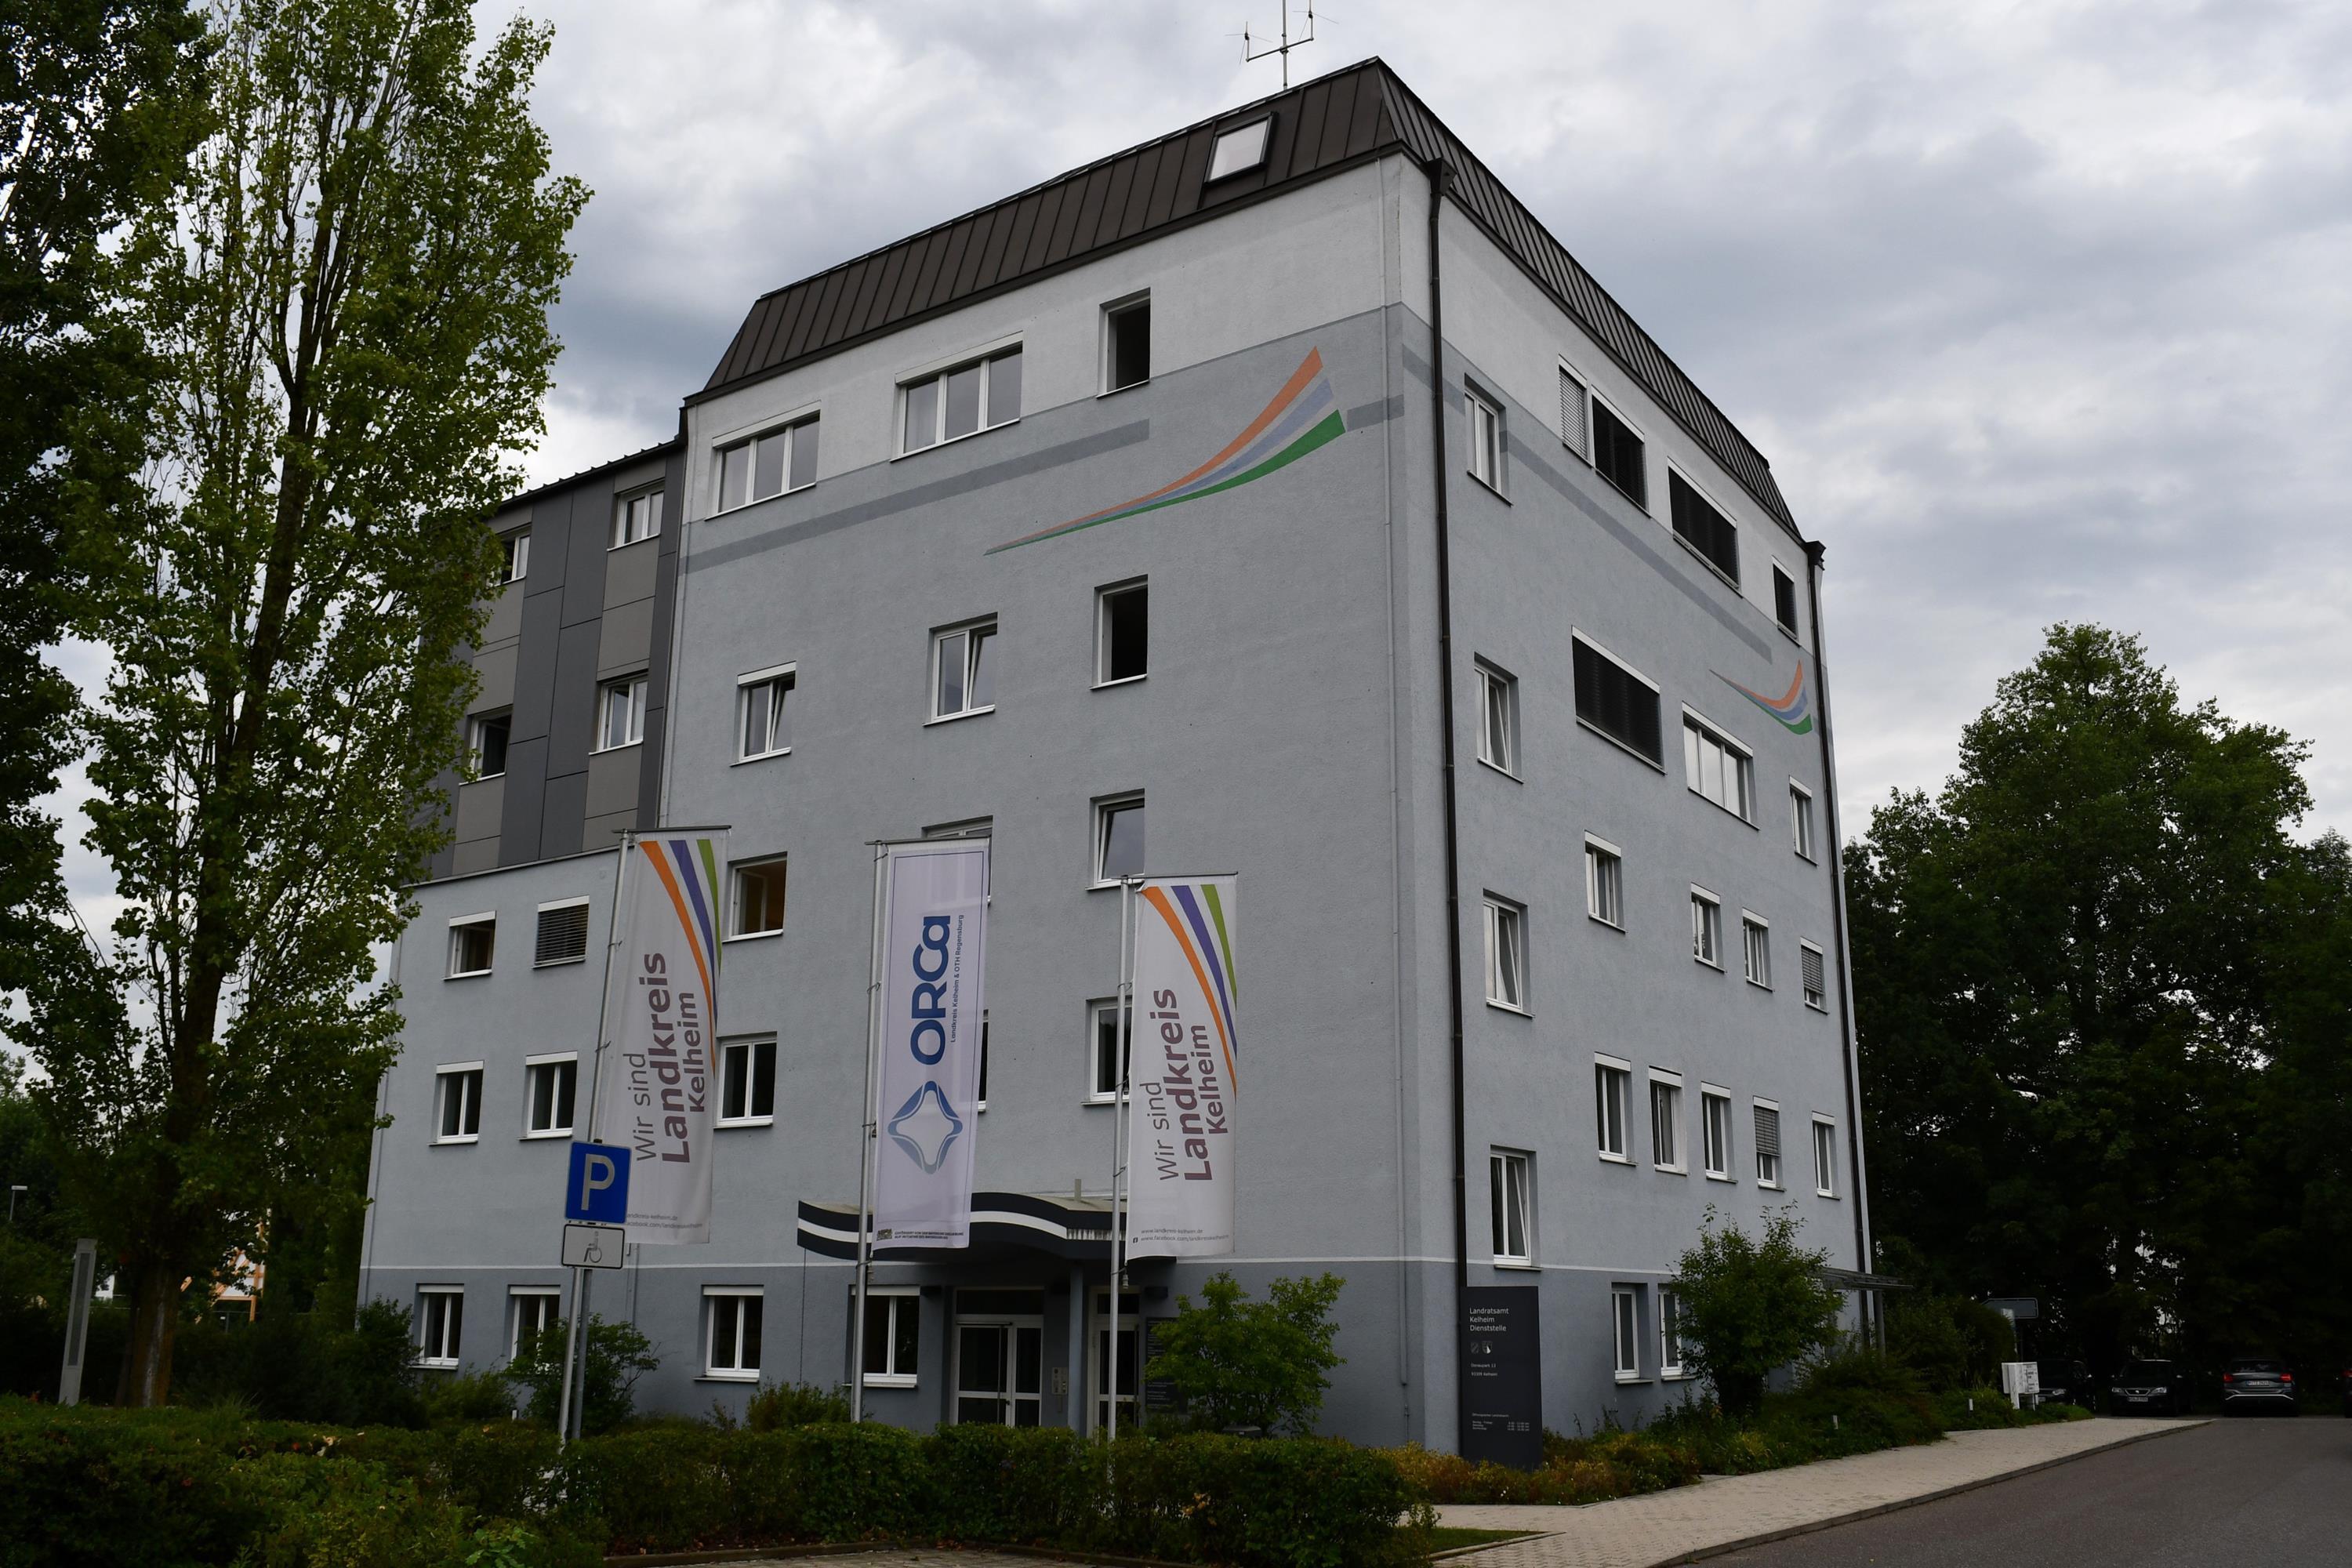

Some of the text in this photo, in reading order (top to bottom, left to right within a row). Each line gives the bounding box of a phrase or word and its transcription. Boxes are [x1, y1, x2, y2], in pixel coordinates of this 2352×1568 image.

[955, 914, 964, 956] Regensburg
[638, 953, 690, 1163] Landkreis
[677, 993, 705, 1112] Kelheim
[1149, 989, 1213, 1180] Landkreis
[1190, 1025, 1229, 1134] Kelheim
[622, 1053, 657, 1161] Wir sind
[1139, 1082, 1179, 1180] Wir sind
[581, 1153, 615, 1210] P
